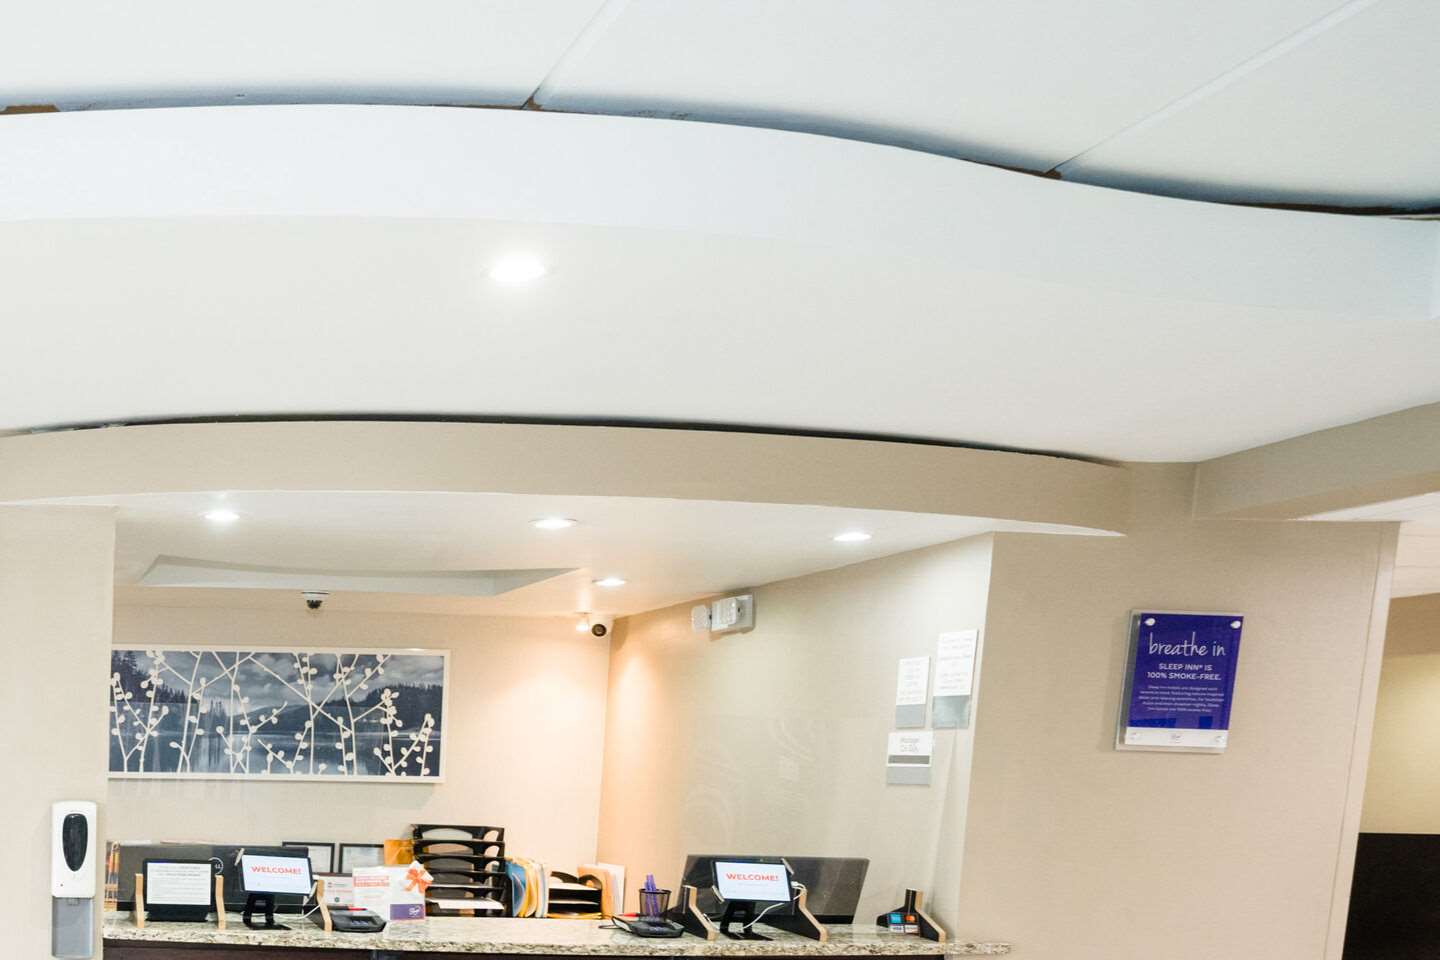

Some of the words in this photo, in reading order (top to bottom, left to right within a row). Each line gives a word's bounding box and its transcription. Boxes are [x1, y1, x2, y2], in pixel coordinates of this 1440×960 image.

[1148, 631, 1209, 656] breathe
[1212, 641, 1226, 656] in
[1147, 671, 1168, 679] 100%
[251, 865, 303, 875] WELCOME!
[726, 872, 780, 881] WELCOME!
